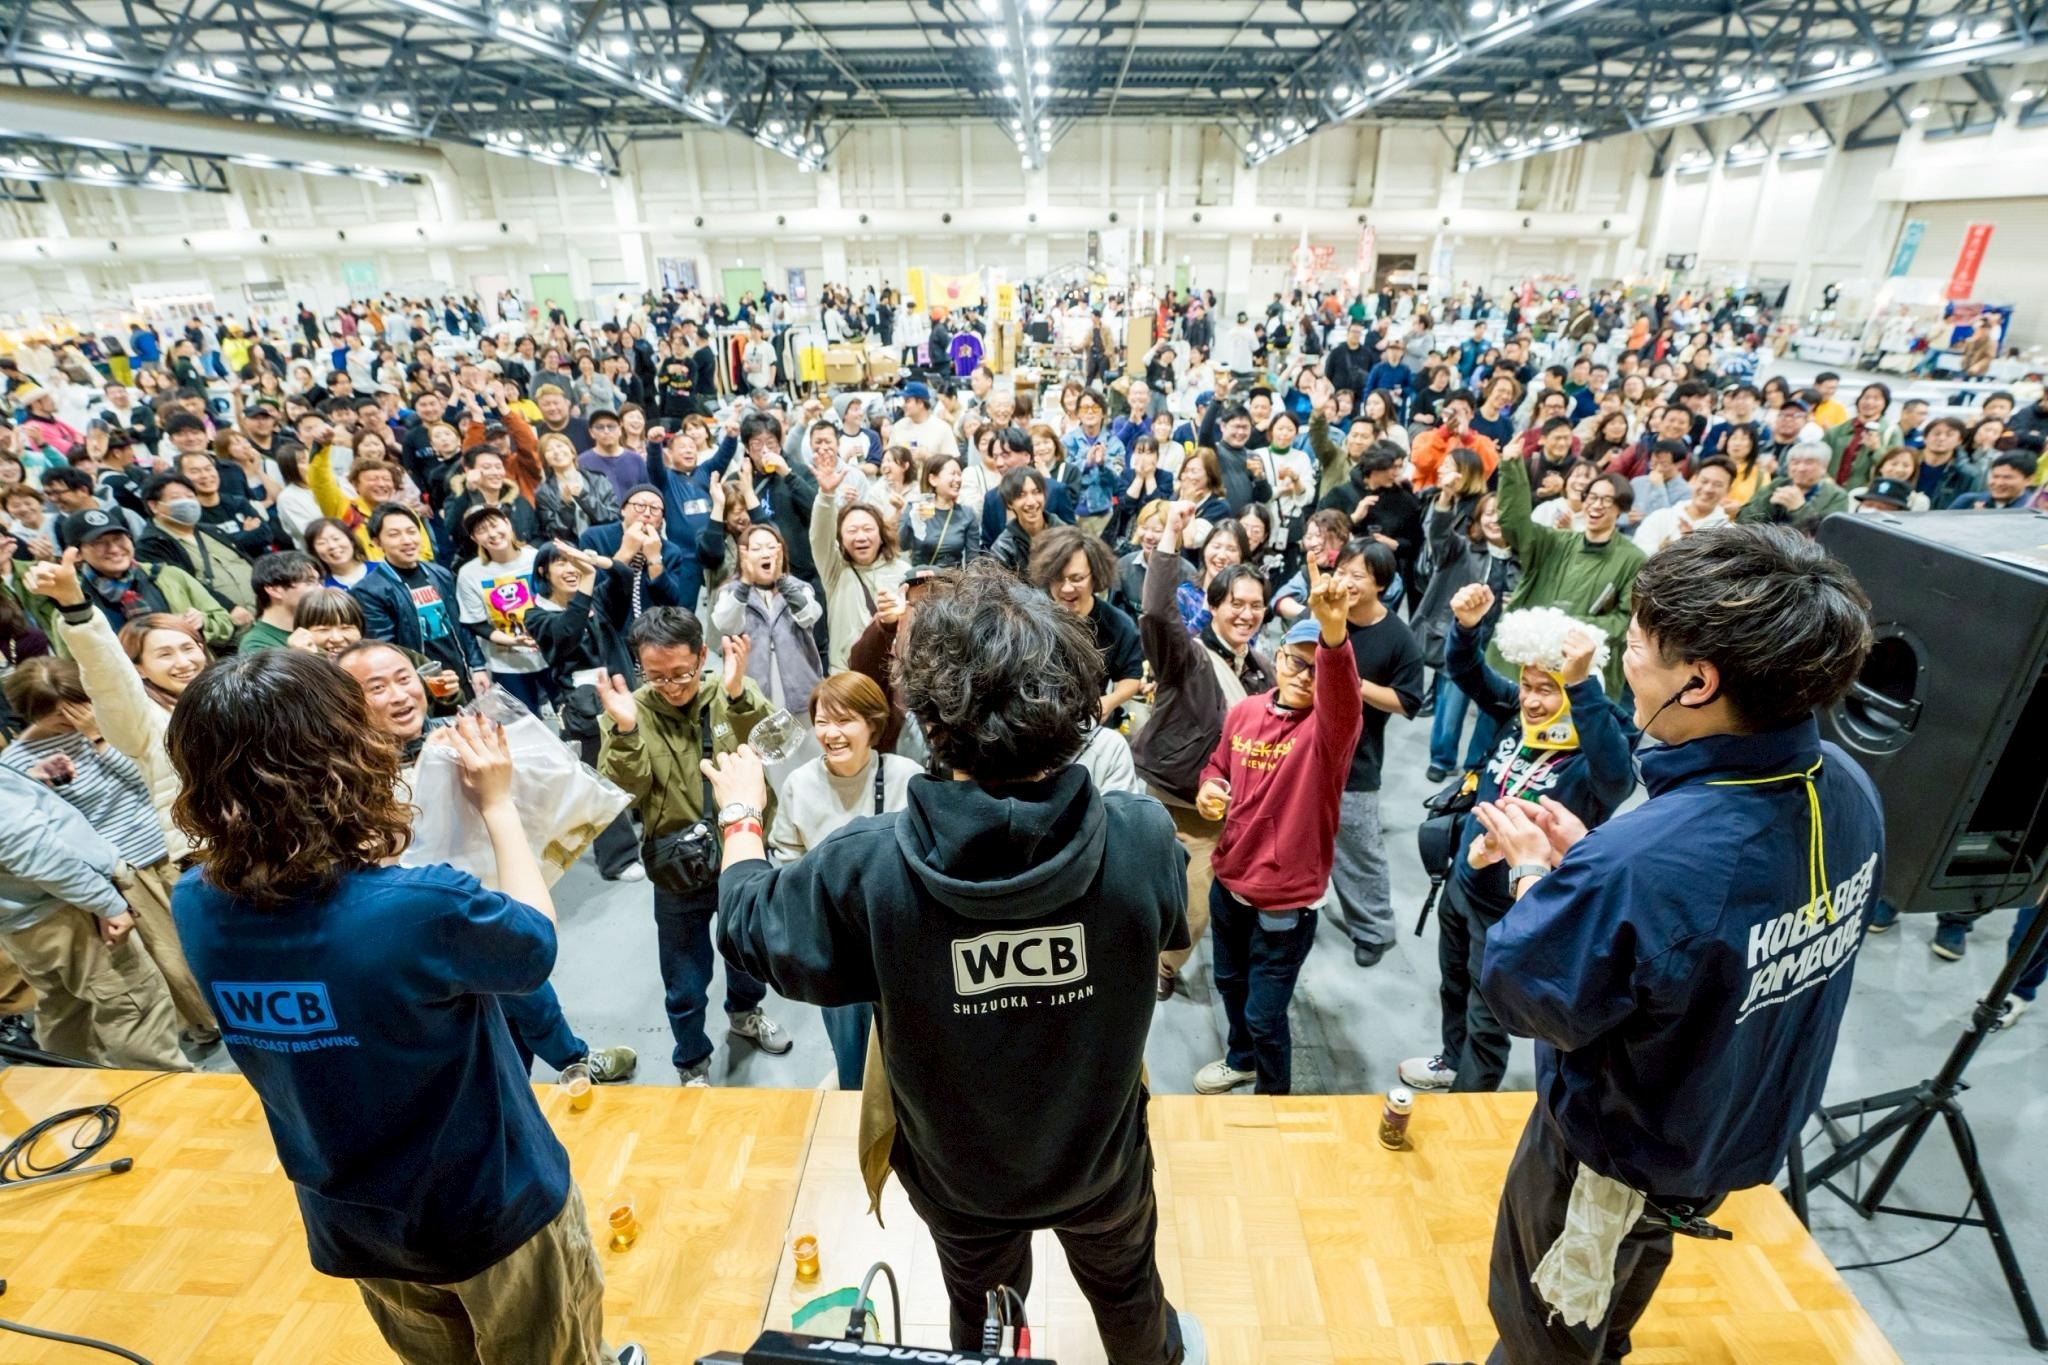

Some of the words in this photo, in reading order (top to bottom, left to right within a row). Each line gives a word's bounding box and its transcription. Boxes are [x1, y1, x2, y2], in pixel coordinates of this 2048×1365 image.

[1747, 890, 1832, 969] KOBE
[961, 937, 1078, 985] WCB
[1738, 909, 1863, 1012] JAMBORE
[221, 991, 326, 1026] WCB
[953, 996, 1029, 1015] SHIZUOKA
[1050, 985, 1095, 1006] JAPAN
[251, 1038, 290, 1053] COAST
[292, 1036, 360, 1052] BREWING
